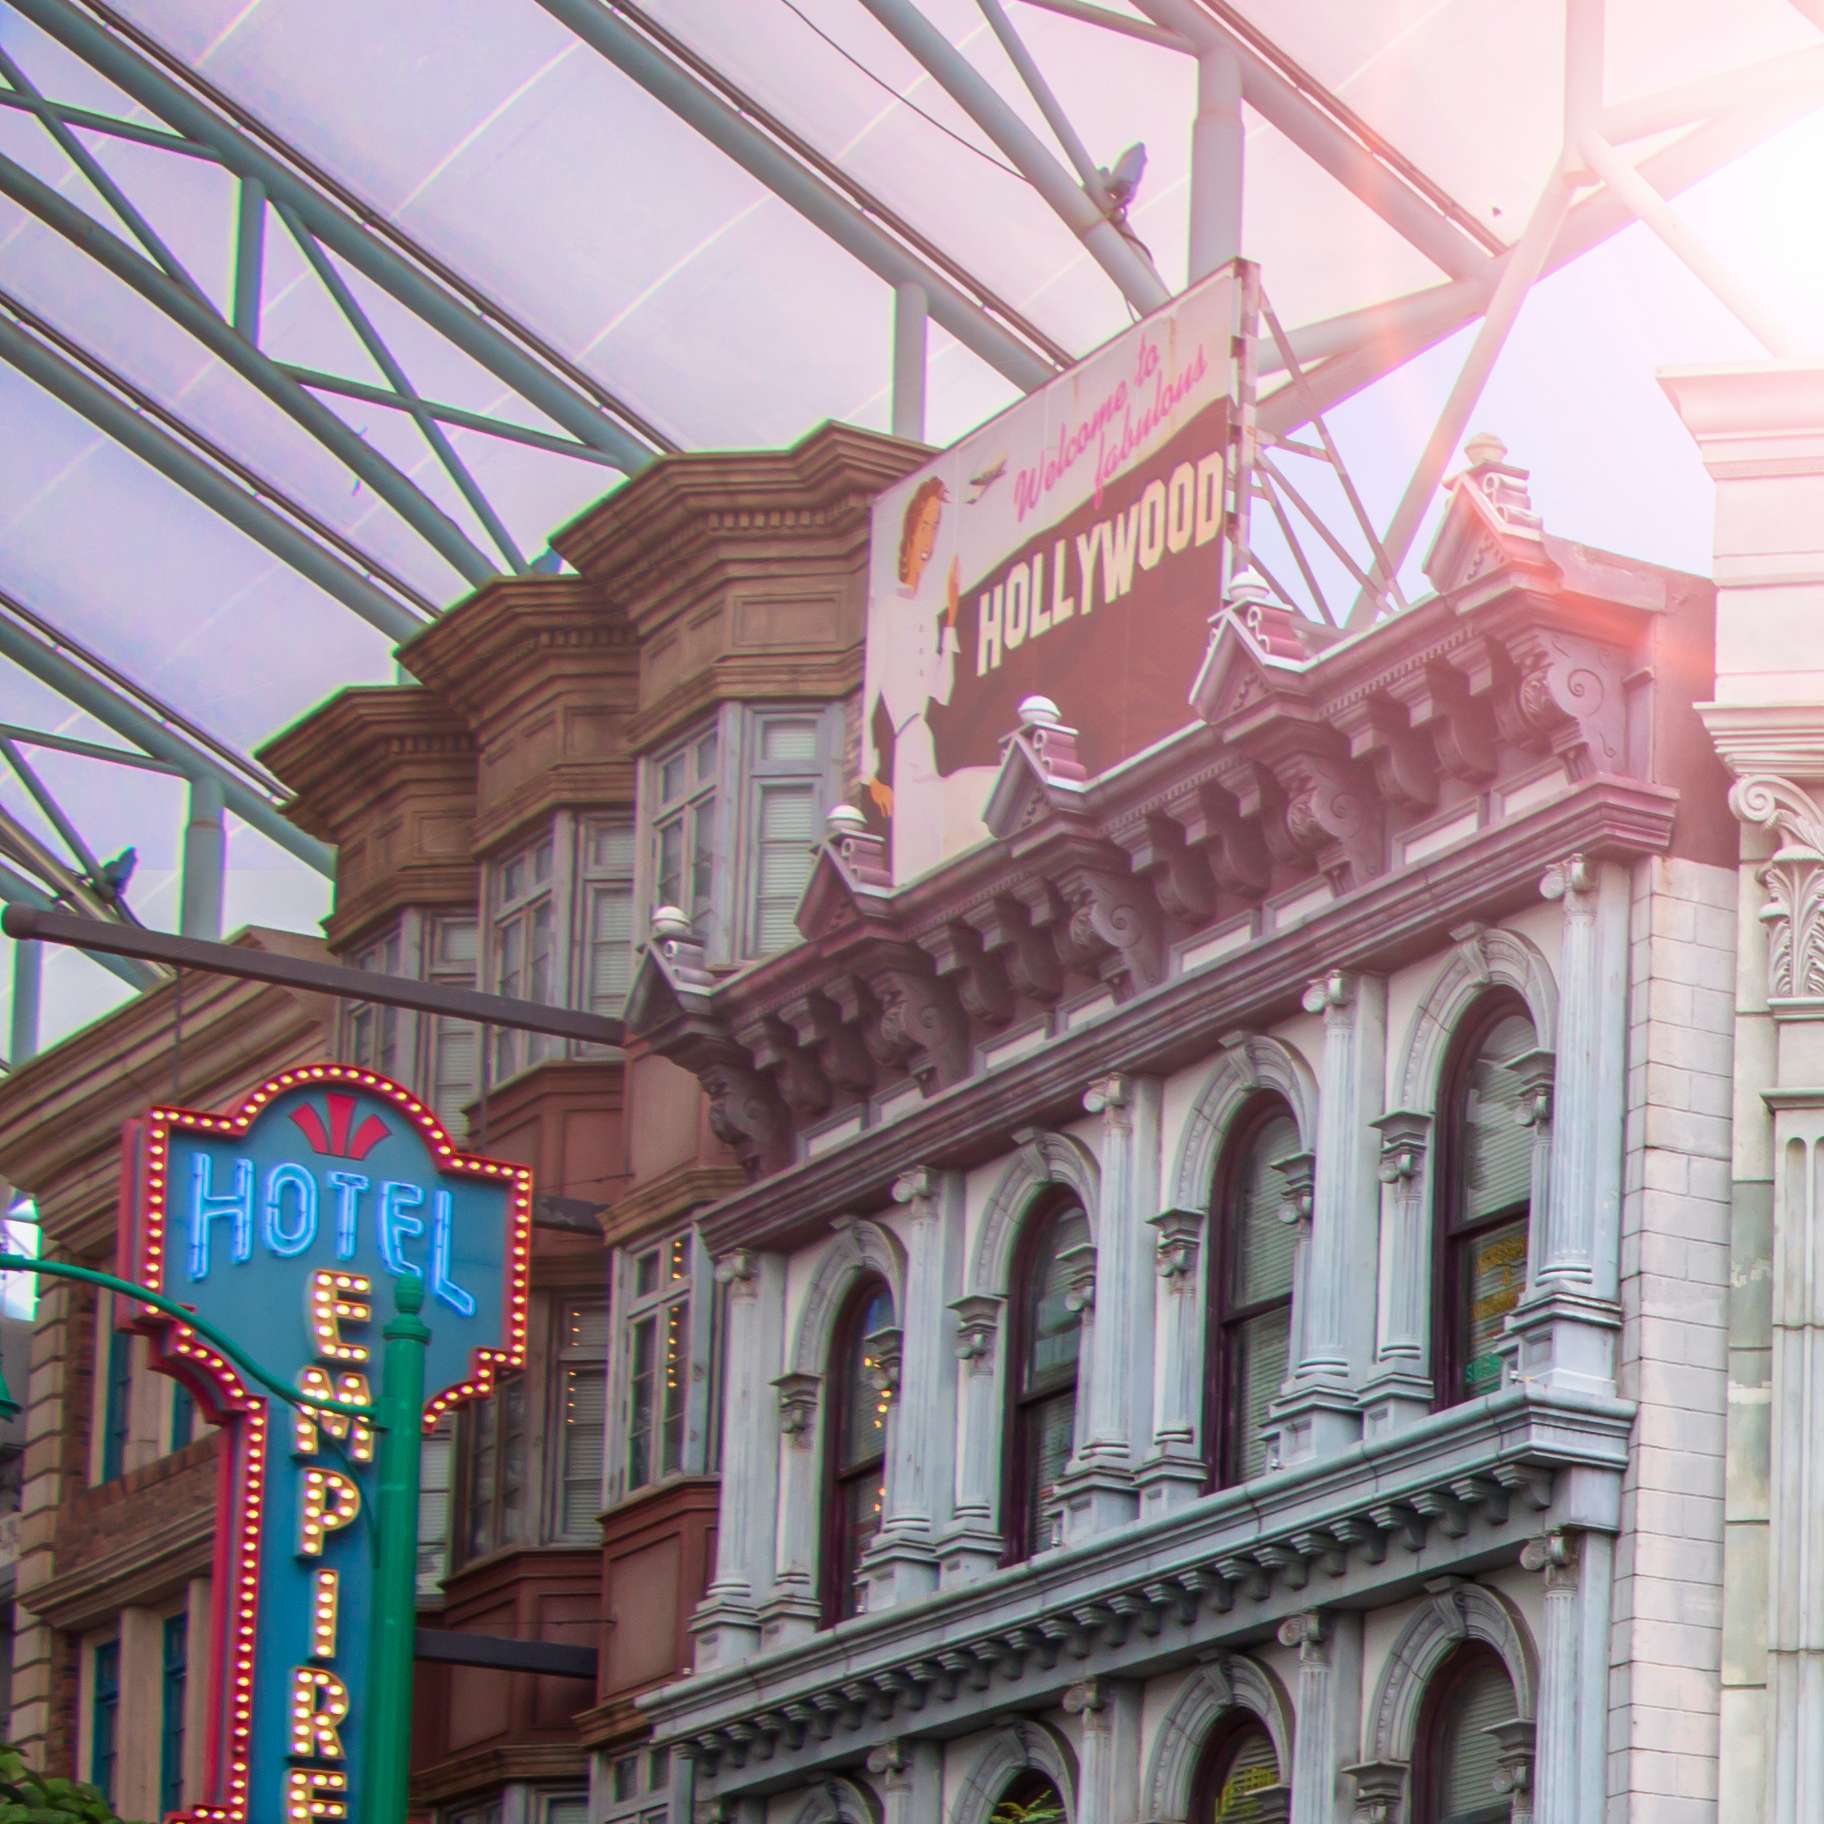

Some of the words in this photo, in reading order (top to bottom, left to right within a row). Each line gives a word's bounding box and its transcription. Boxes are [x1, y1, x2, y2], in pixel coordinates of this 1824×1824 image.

[1014, 379, 1128, 524] Welcome
[1134, 332, 1161, 389] to
[974, 450, 1226, 678] HOLLYWOOD
[188, 1151, 477, 1318] HOTEL
